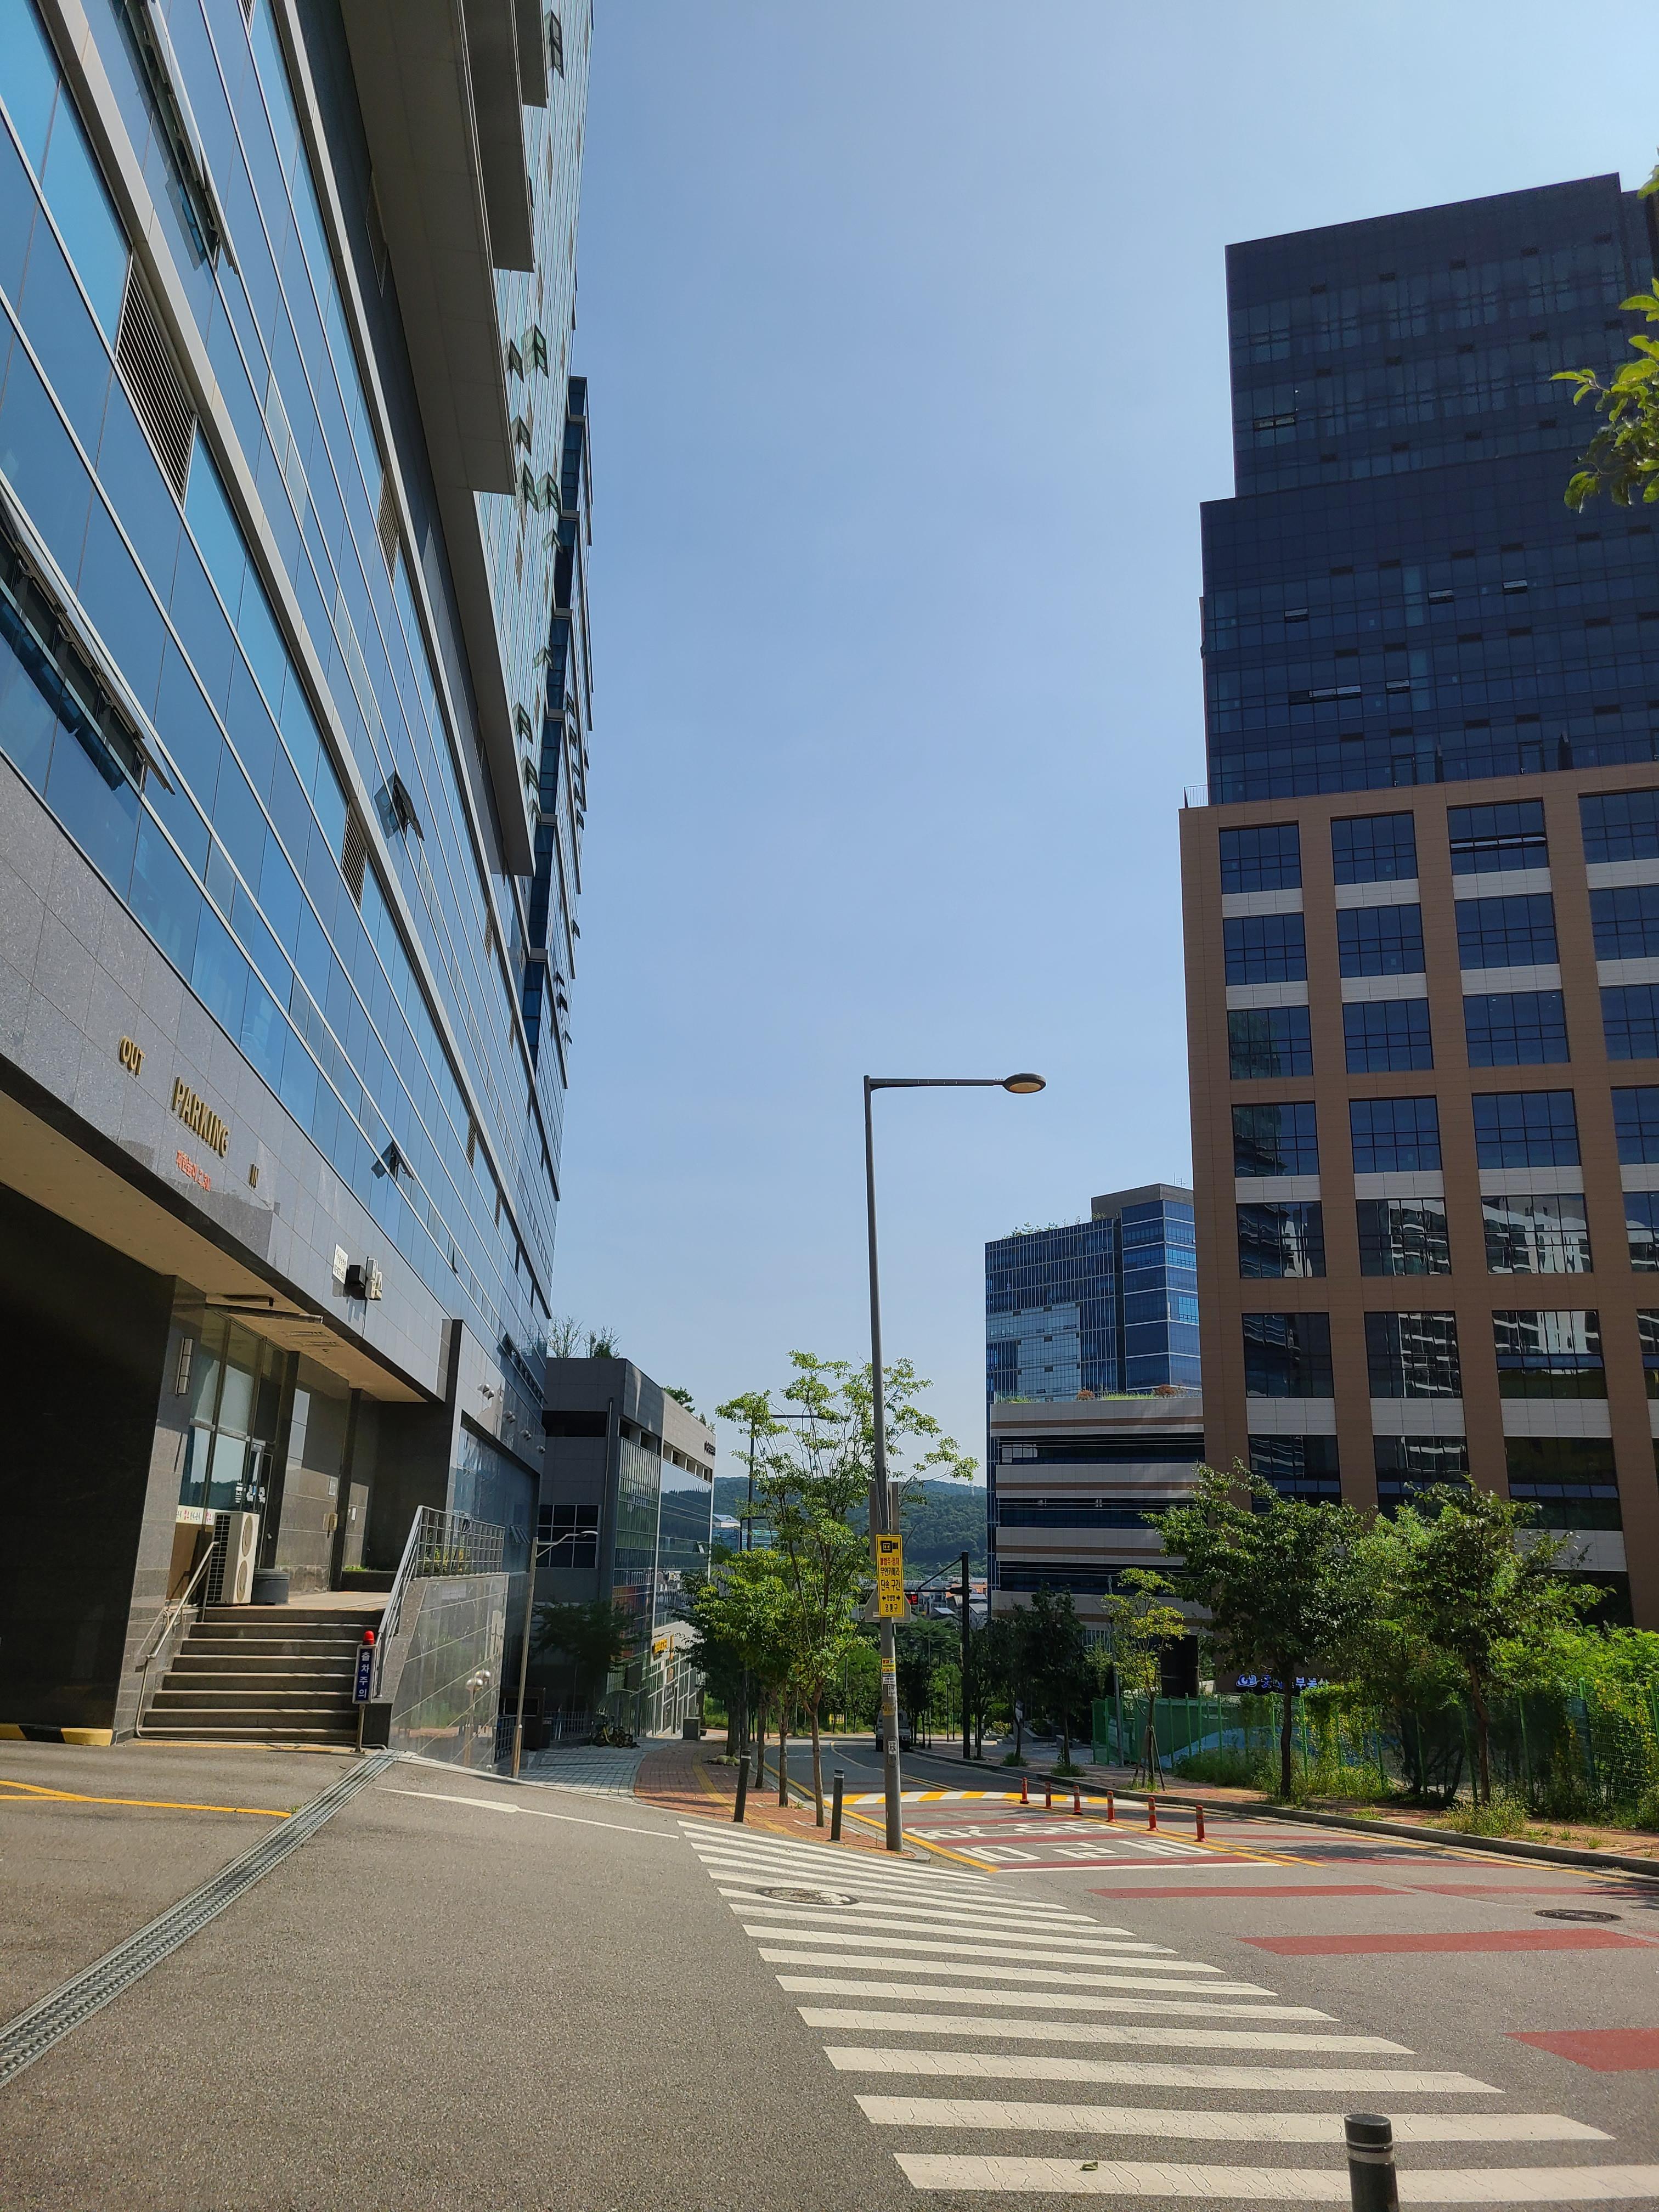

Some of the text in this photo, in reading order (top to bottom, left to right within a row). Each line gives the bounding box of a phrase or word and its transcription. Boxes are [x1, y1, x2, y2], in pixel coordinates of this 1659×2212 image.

[120, 1036, 145, 1075] OUT
[172, 1076, 230, 1159] PARKING
[249, 1163, 259, 1188] IN
[880, 1567, 900, 1576] 무인카메라
[881, 1579, 900, 1591] 단속 구간
[885, 1604, 898, 1612] 영통구
[358, 1651, 370, 1699] 출차주의
[953, 1839, 1215, 1862] 어린이
